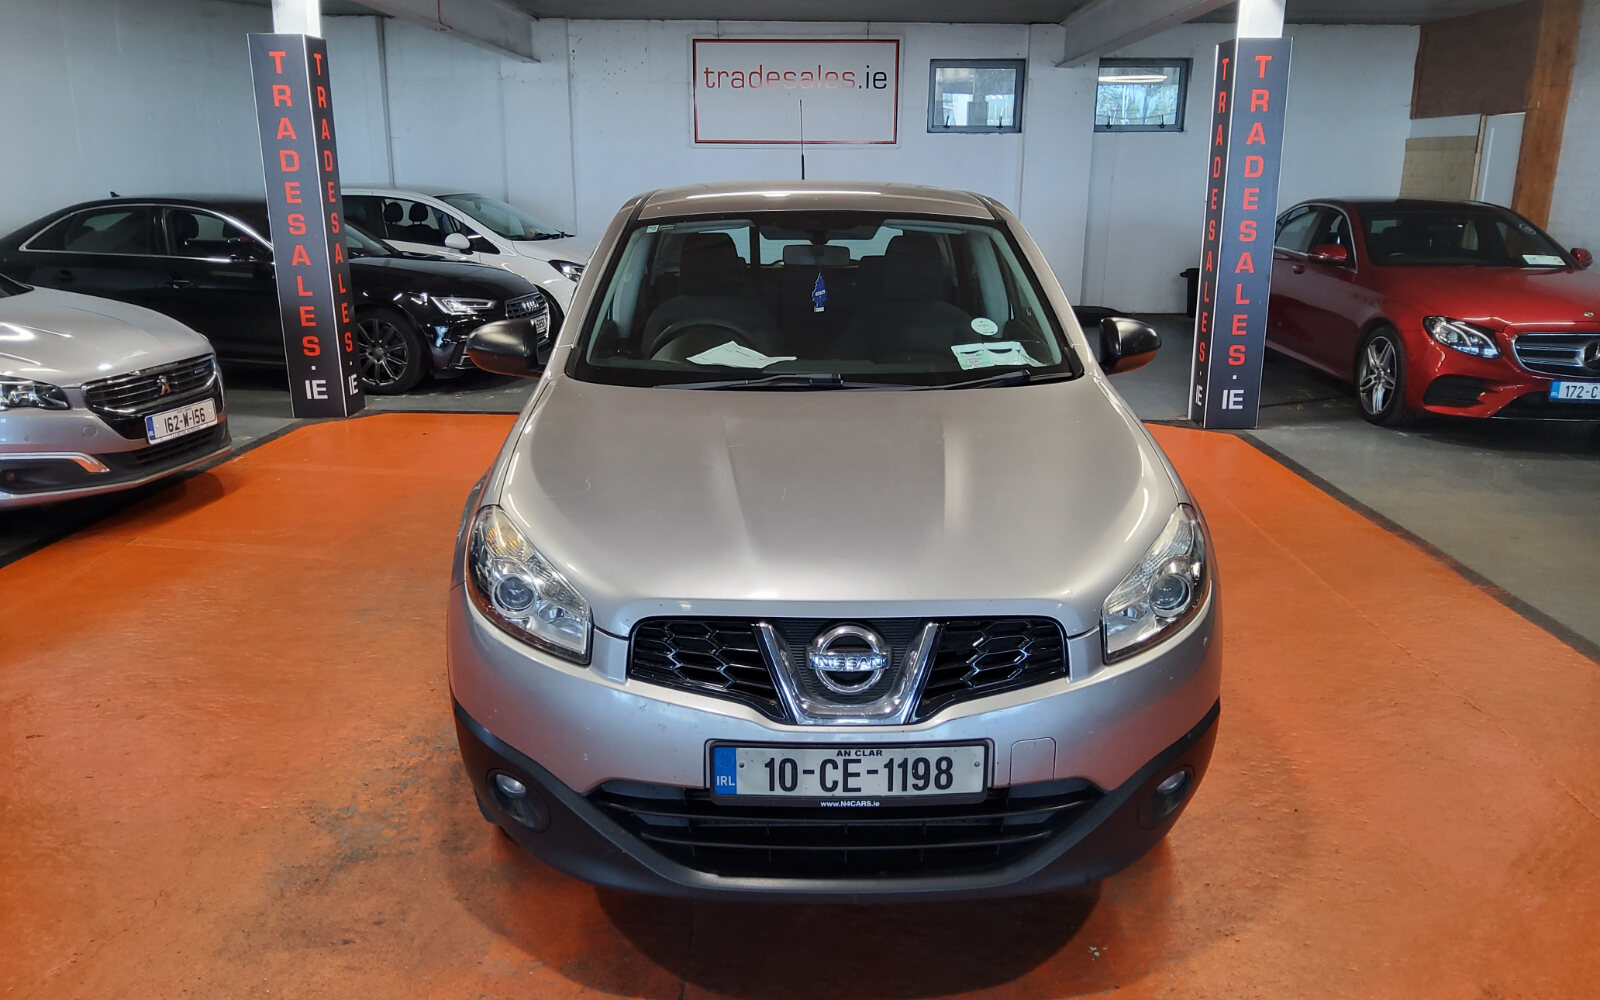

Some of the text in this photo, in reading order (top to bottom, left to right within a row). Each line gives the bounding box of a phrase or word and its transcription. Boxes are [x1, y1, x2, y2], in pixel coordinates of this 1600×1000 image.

[703, 64, 887, 90] tradesales.ie
[1565, 385, 1600, 398] 172-C
[164, 408, 206, 433] 162-W-156
[815, 656, 884, 668] NISSAN
[716, 776, 736, 787] IRL
[764, 756, 954, 793] 10-CE-1198
